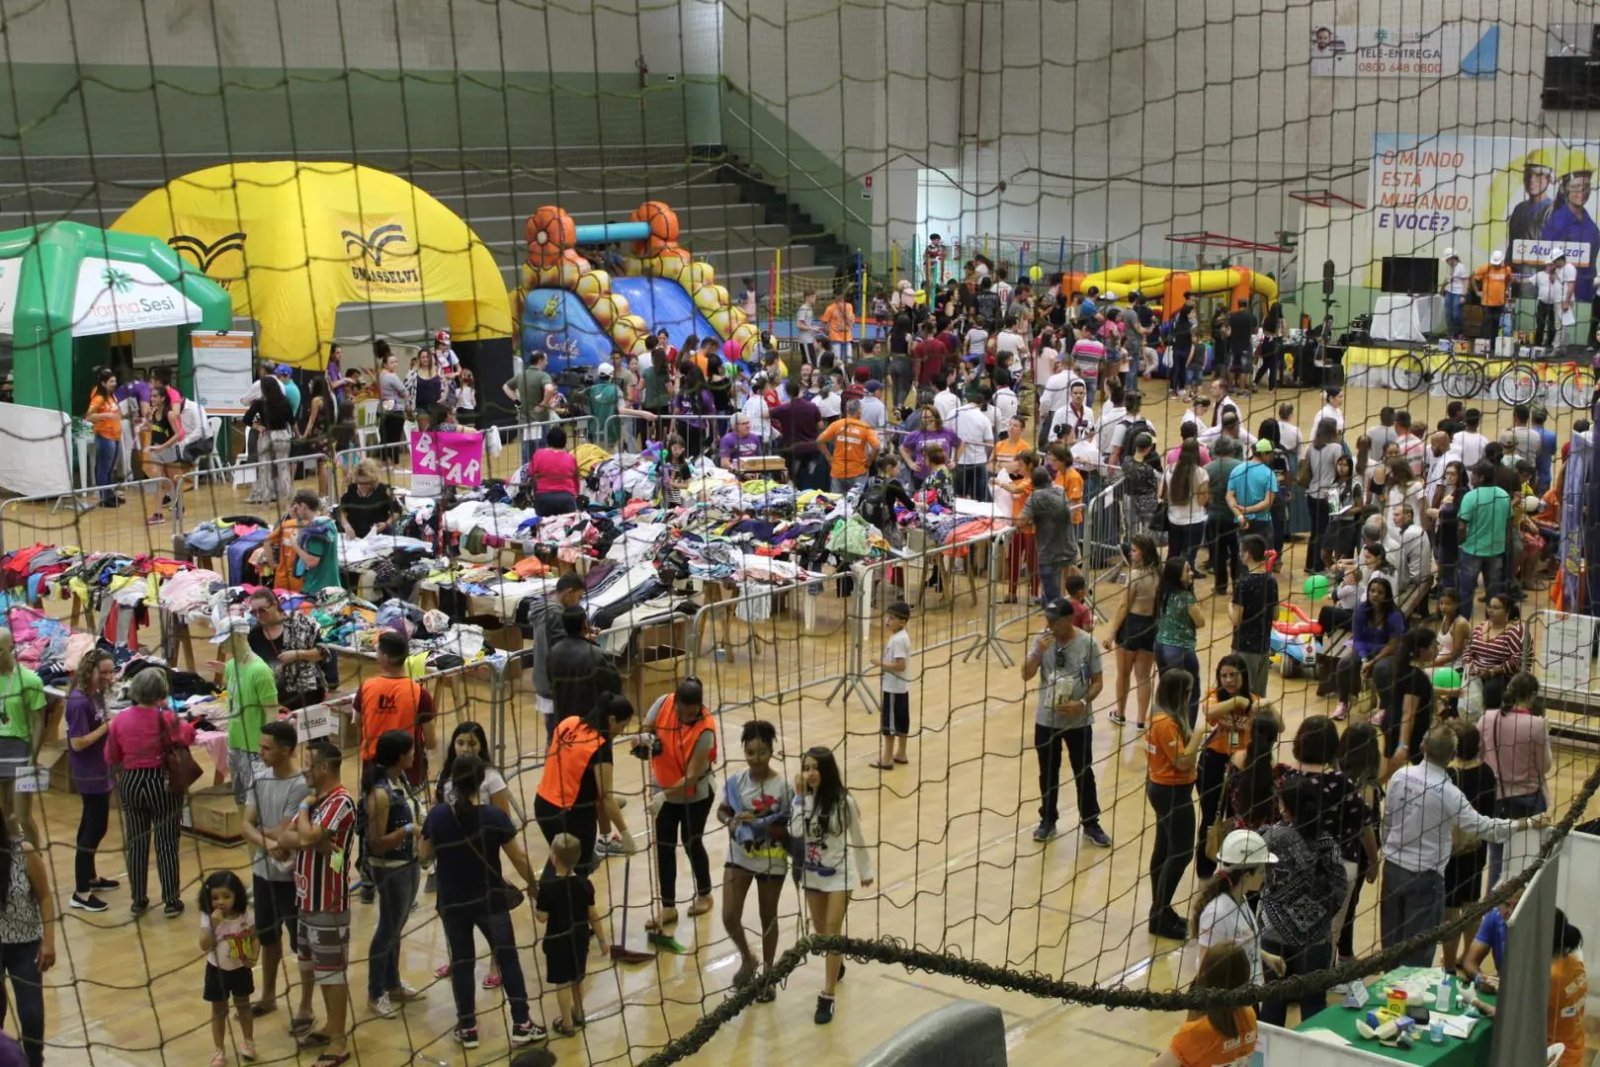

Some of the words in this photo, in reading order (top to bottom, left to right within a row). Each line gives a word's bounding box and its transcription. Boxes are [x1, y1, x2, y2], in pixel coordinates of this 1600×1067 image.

[1360, 48, 1441, 59] TELE-ENTREGA
[1360, 62, 1386, 72] 0800
[1413, 63, 1442, 73] 0800
[1382, 150, 1395, 166] O
[1399, 151, 1465, 168] MUNDO
[1381, 169, 1422, 188] ESTÁ
[1381, 192, 1471, 213] MUDANDO,
[1379, 213, 1391, 228] E
[1395, 211, 1450, 231] VOCÊ?
[415, 432, 480, 484] BAZAR
